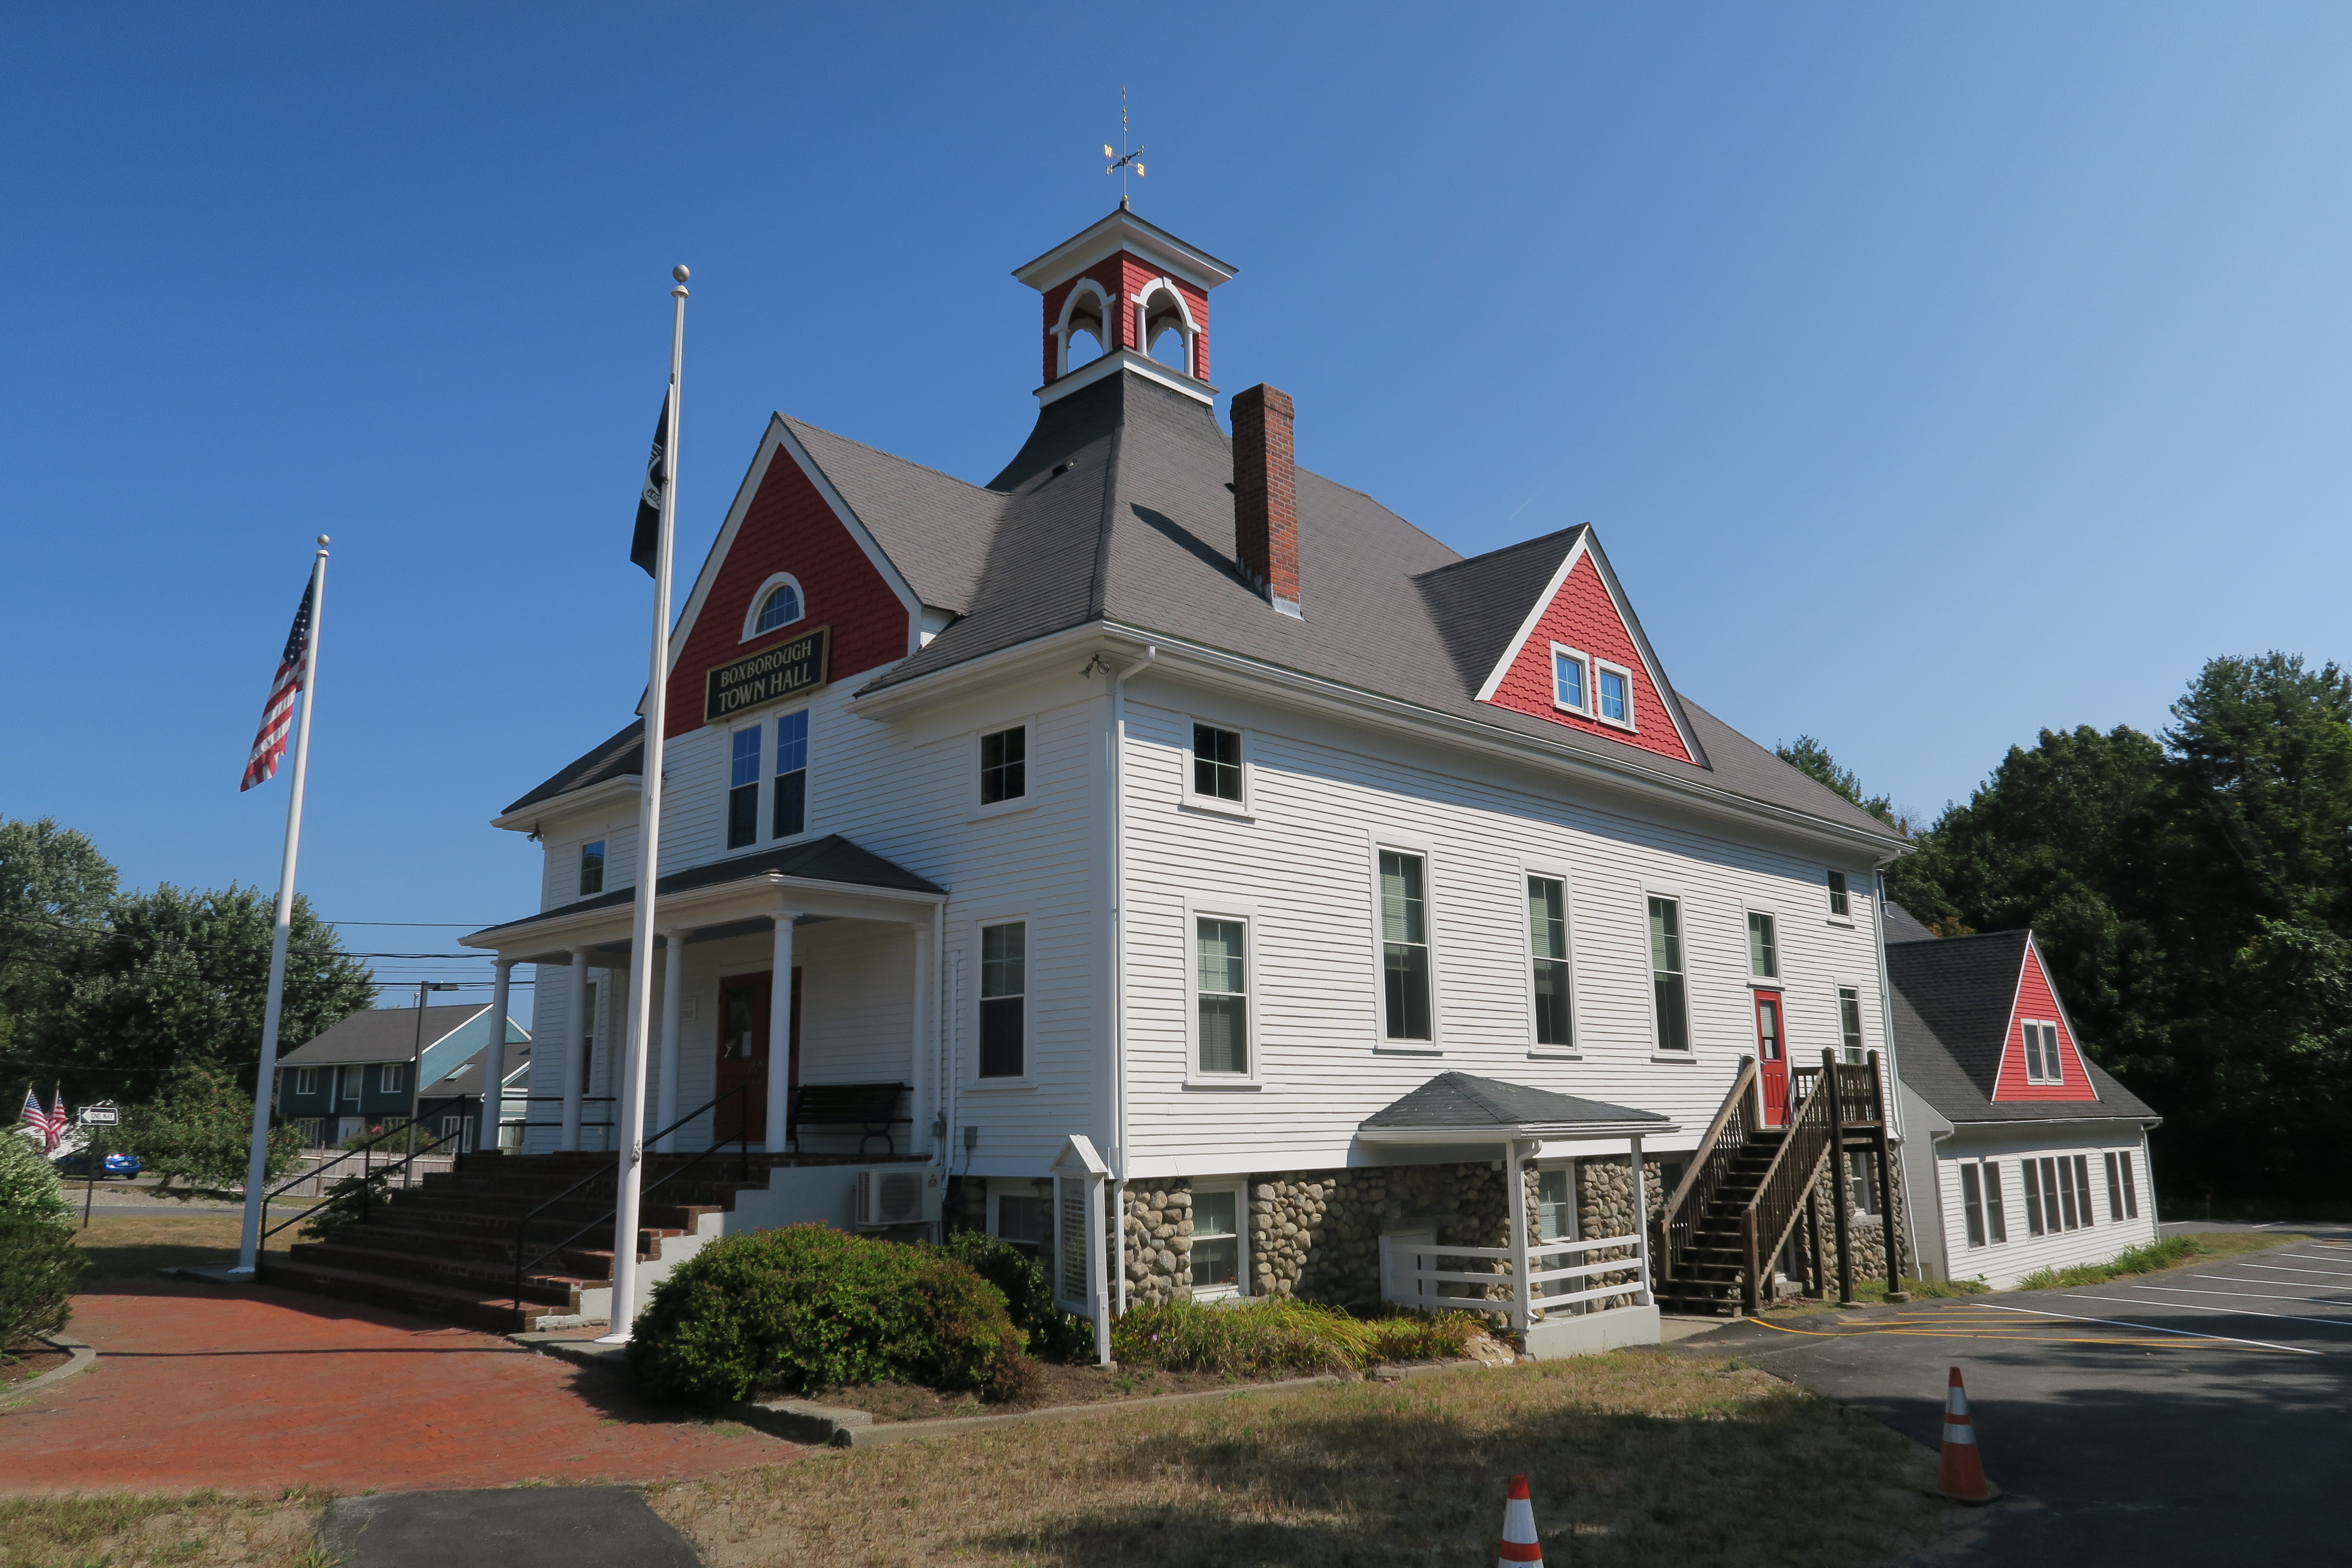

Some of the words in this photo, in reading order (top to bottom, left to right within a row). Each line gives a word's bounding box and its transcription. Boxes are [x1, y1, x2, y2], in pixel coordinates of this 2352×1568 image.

[1104, 144, 1112, 158] W
[1106, 164, 1113, 175] N
[721, 639, 812, 688] BOXBOROUGH
[719, 678, 766, 712] TOWN
[770, 663, 812, 695] HALL
